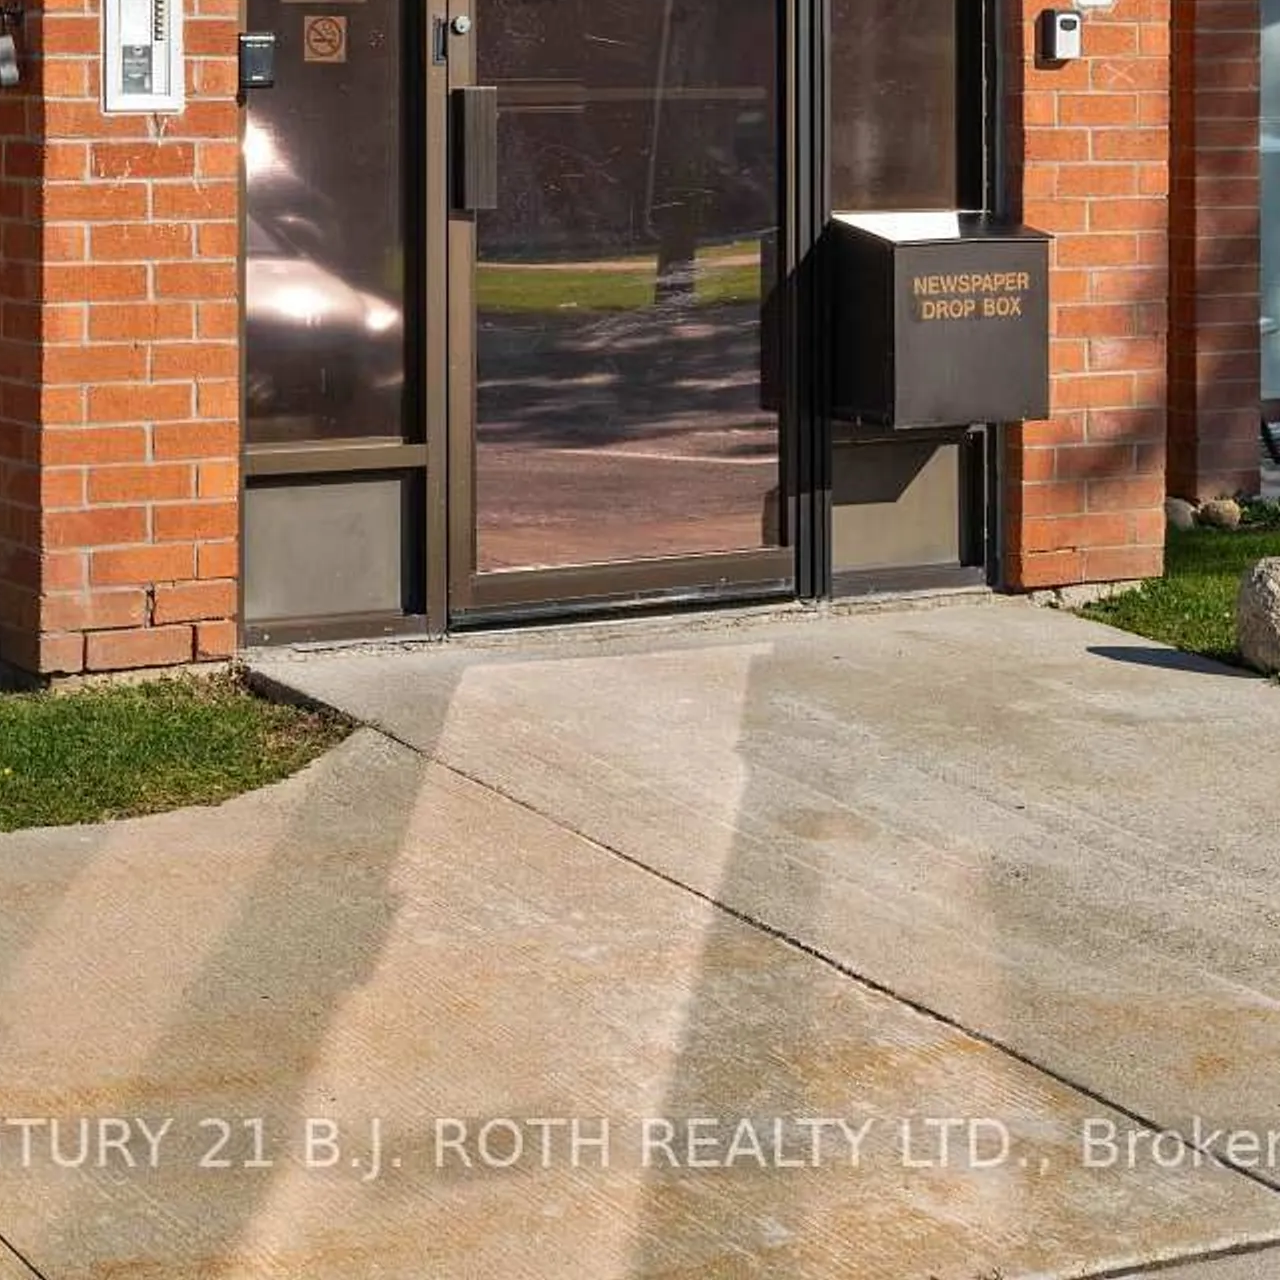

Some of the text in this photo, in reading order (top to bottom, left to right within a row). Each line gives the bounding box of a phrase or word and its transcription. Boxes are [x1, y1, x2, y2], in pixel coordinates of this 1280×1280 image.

[913, 272, 1029, 294] NEWSPAPER
[922, 297, 1022, 319] DROP BOX
